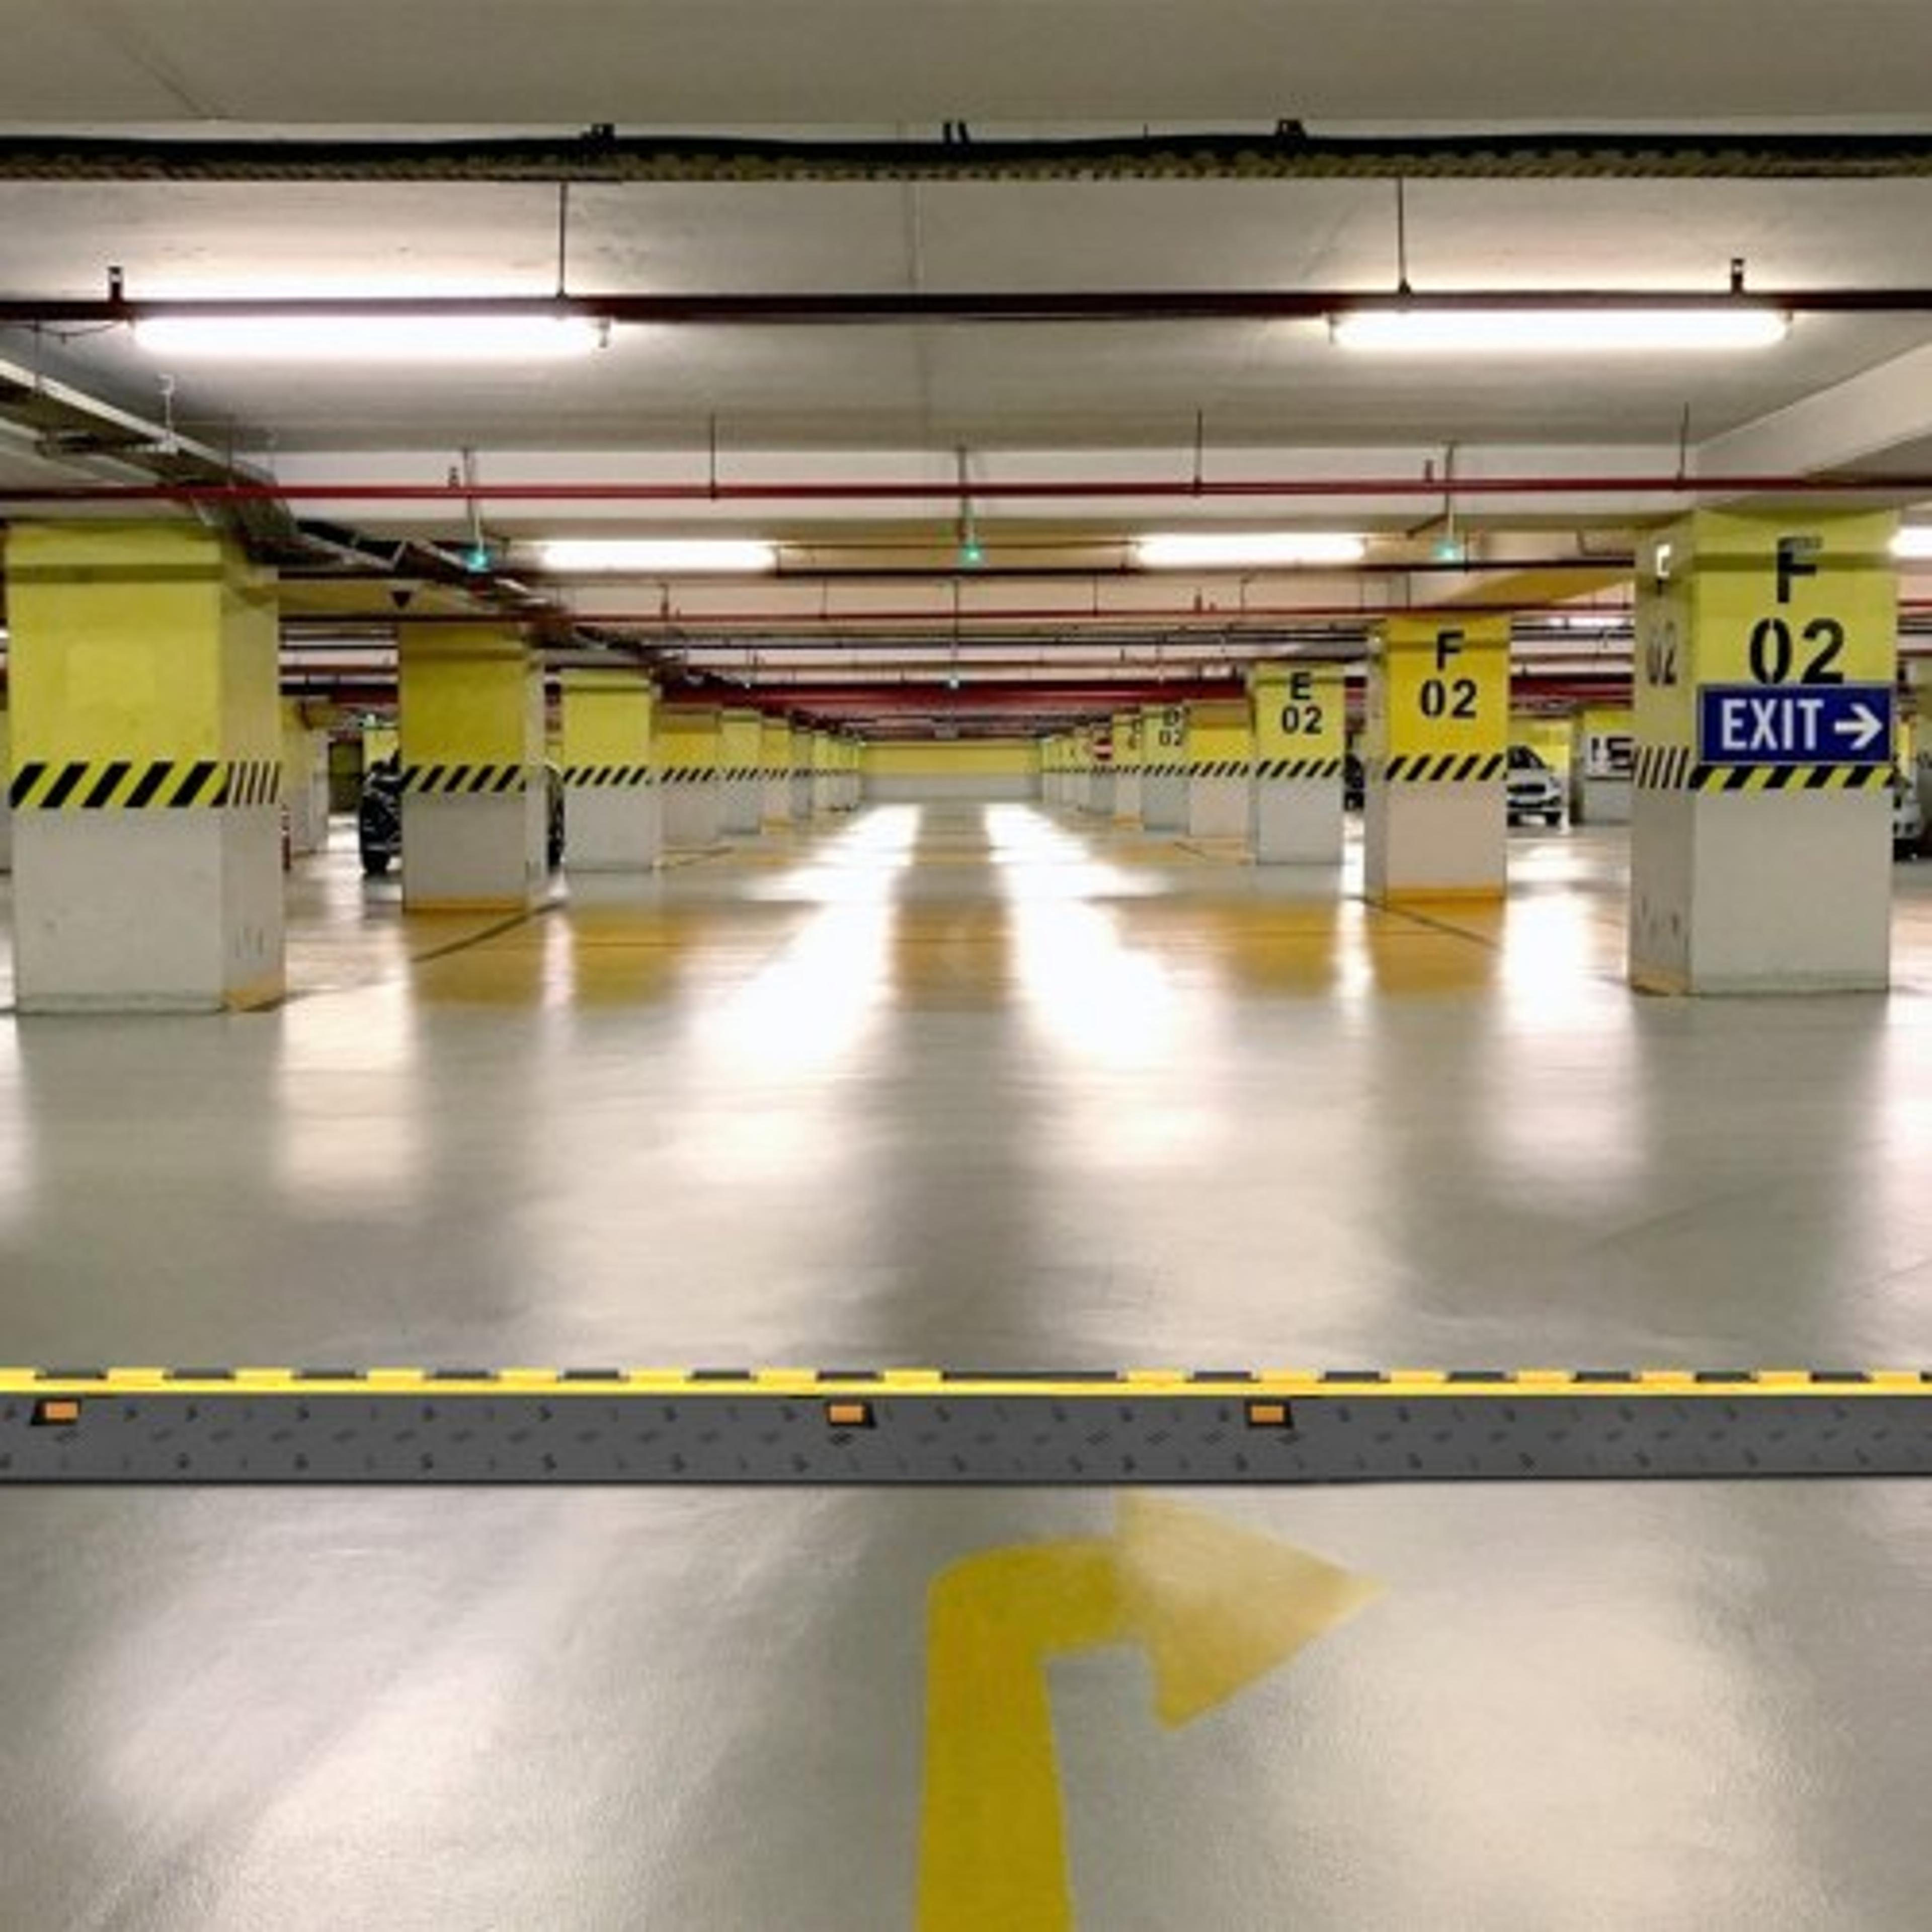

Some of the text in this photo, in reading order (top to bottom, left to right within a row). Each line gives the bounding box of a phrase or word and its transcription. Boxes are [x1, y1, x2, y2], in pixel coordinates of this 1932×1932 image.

[1777, 536, 1822, 603] F
[1437, 630, 1464, 670] F
[1749, 618, 1844, 684] 02
[1291, 672, 1311, 699] E
[1420, 679, 1477, 719] 02
[1282, 706, 1322, 735] 02
[1722, 699, 1824, 750] EXIT
